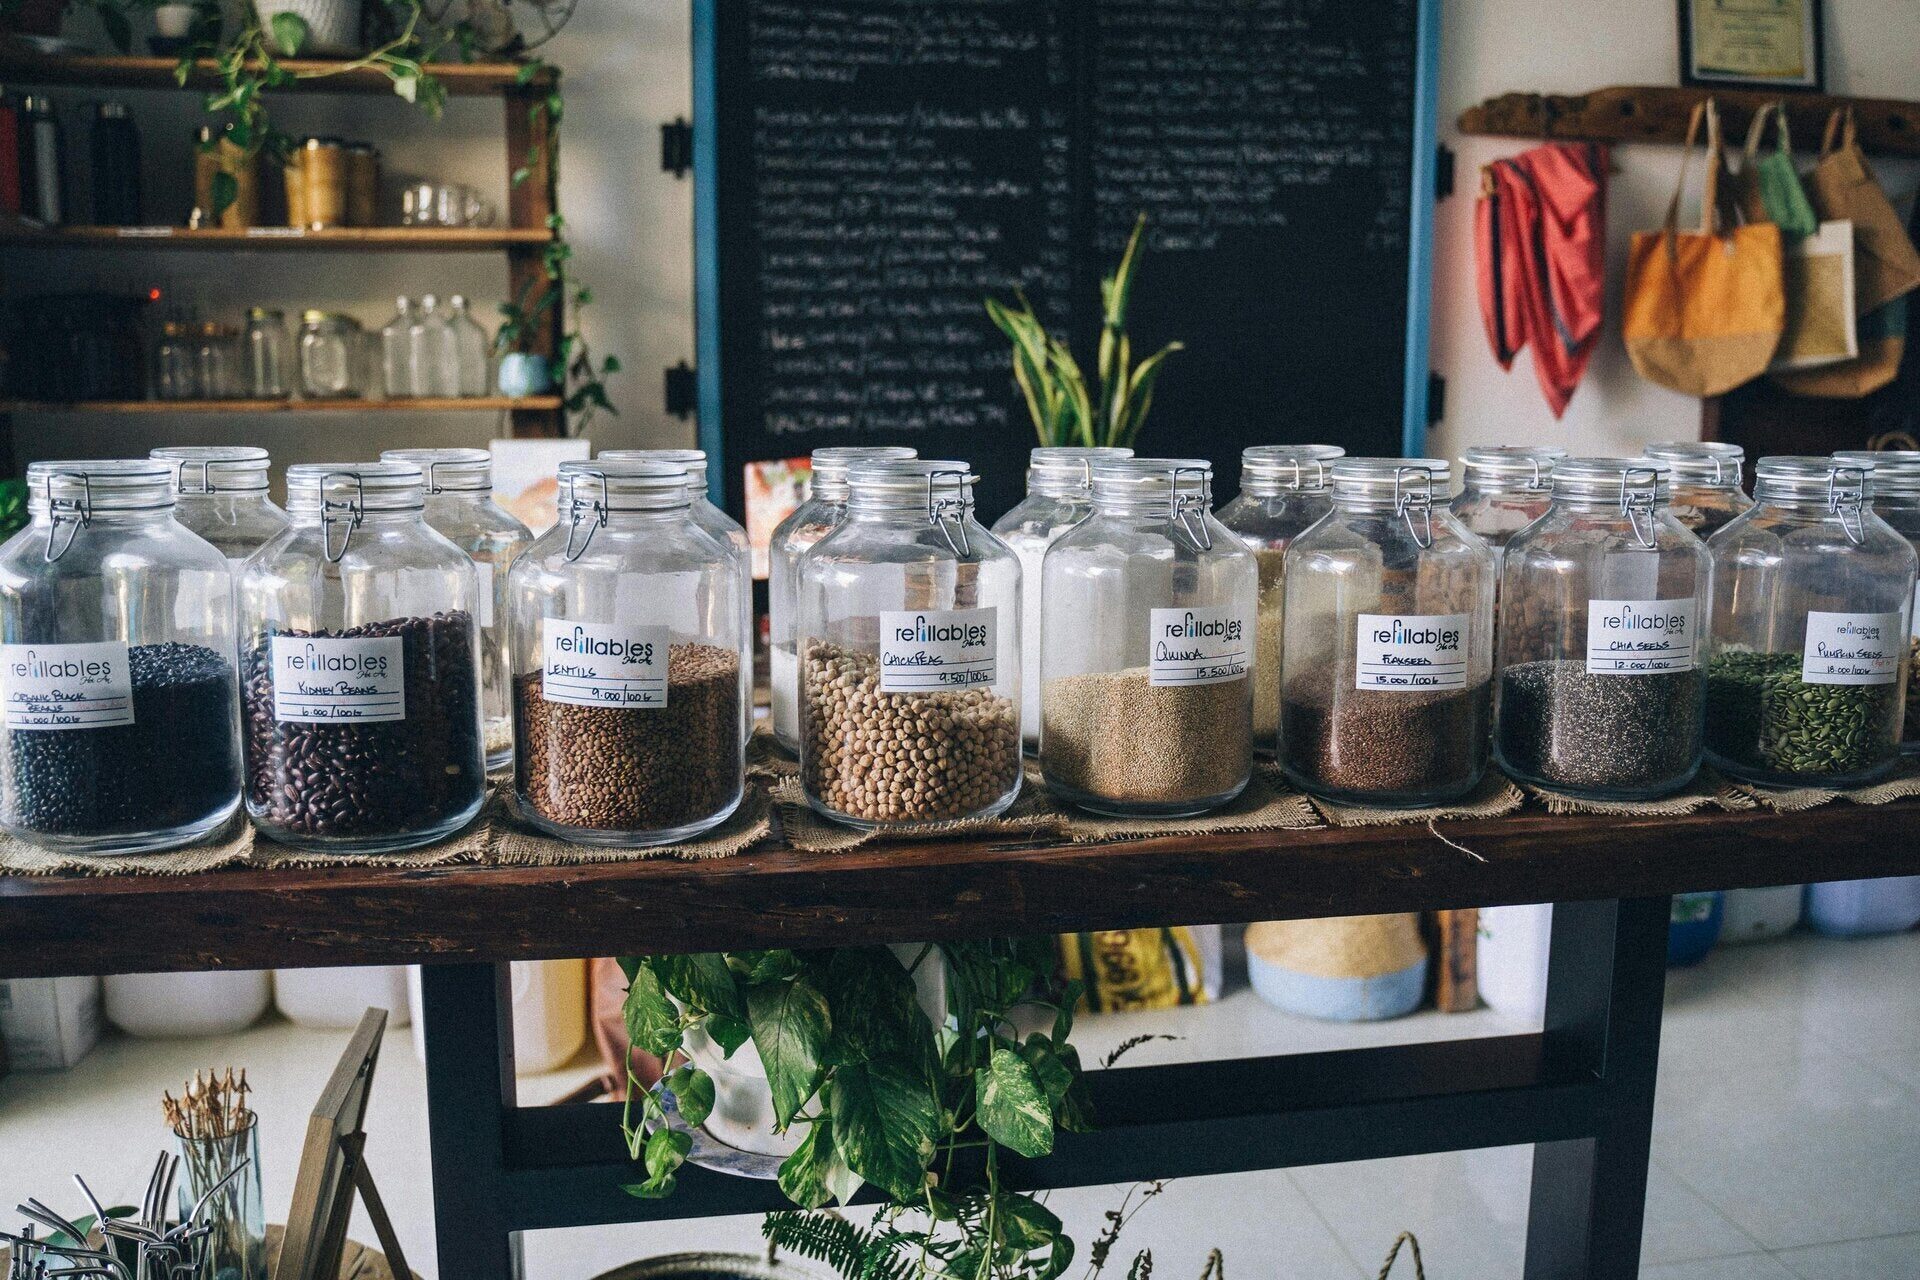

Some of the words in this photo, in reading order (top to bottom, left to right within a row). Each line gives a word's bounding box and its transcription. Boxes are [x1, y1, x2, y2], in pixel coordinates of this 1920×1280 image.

[896, 615, 987, 643] refillables
[1166, 612, 1242, 638] refillables
[1603, 605, 1686, 630] refillables
[1836, 621, 1880, 636] refillables
[556, 626, 653, 657] refillables
[1373, 619, 1459, 644] refillables
[287, 643, 387, 671] refillables
[1610, 640, 1635, 651] CHIA
[1636, 640, 1670, 651] SEEDS
[1817, 641, 1855, 659] PUMPKIN
[1856, 648, 1883, 659] SEEDS
[11, 650, 112, 678] refillables
[547, 656, 597, 678] LENTILS
[51, 689, 86, 701] BLACK
[298, 681, 334, 695] KIDNEY
[336, 681, 378, 695] BEANS
[26, 702, 64, 713] BEANS
